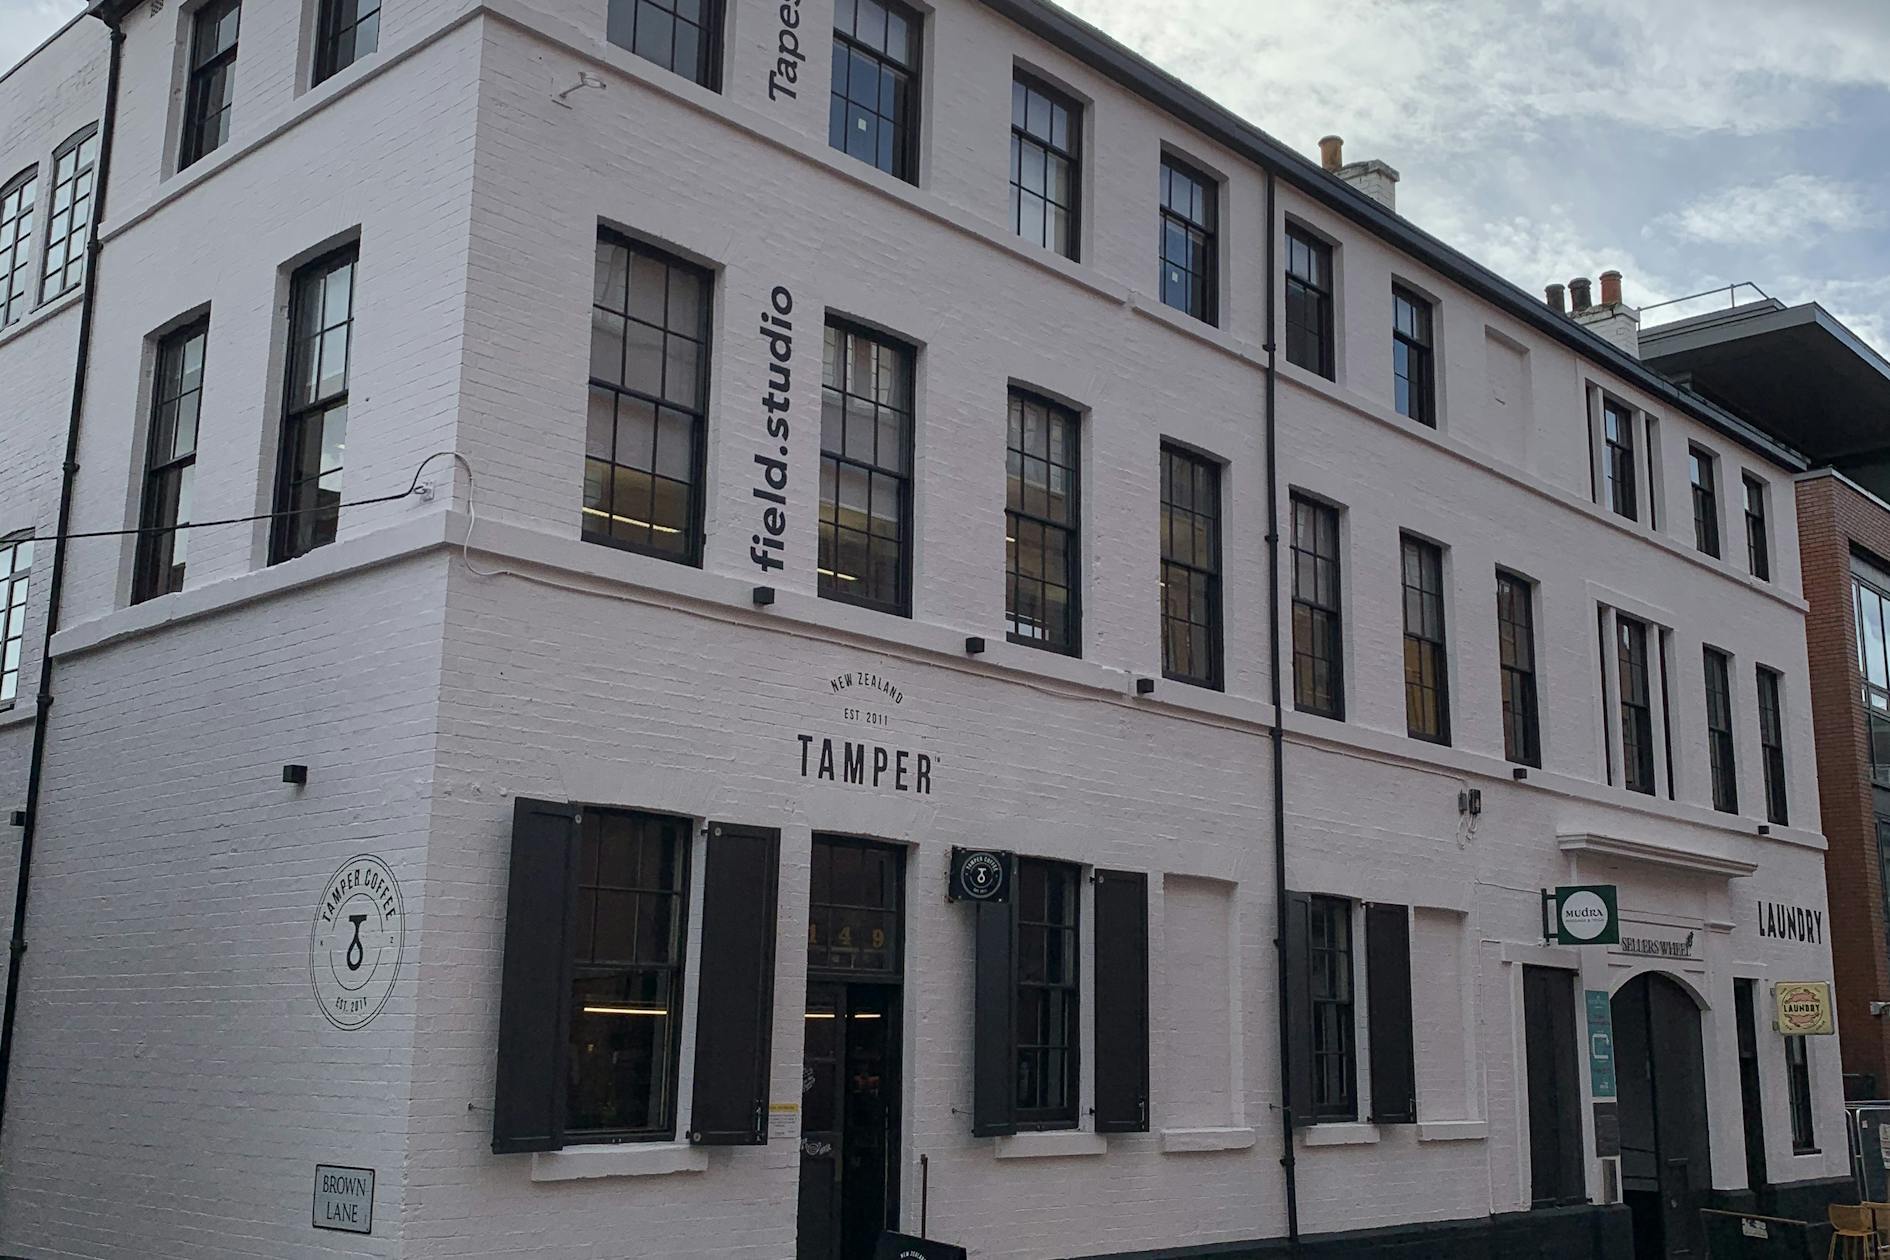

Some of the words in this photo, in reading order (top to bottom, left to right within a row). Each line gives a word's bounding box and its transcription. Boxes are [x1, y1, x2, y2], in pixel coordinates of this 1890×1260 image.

[750, 286, 793, 572] field.studio
[831, 673, 853, 693] NEW
[858, 672, 904, 704] ZEALAND
[844, 708, 860, 721] EST
[866, 712, 888, 726] 2011
[797, 734, 931, 795] TAMPER
[322, 869, 360, 923] TAMPER
[364, 869, 396, 921] COFFEE
[1758, 901, 1822, 945] LAUNDRY
[1783, 1004, 1820, 1013] LAUNDRY
[322, 1175, 367, 1197] BROWN
[326, 1201, 358, 1223] LANE
